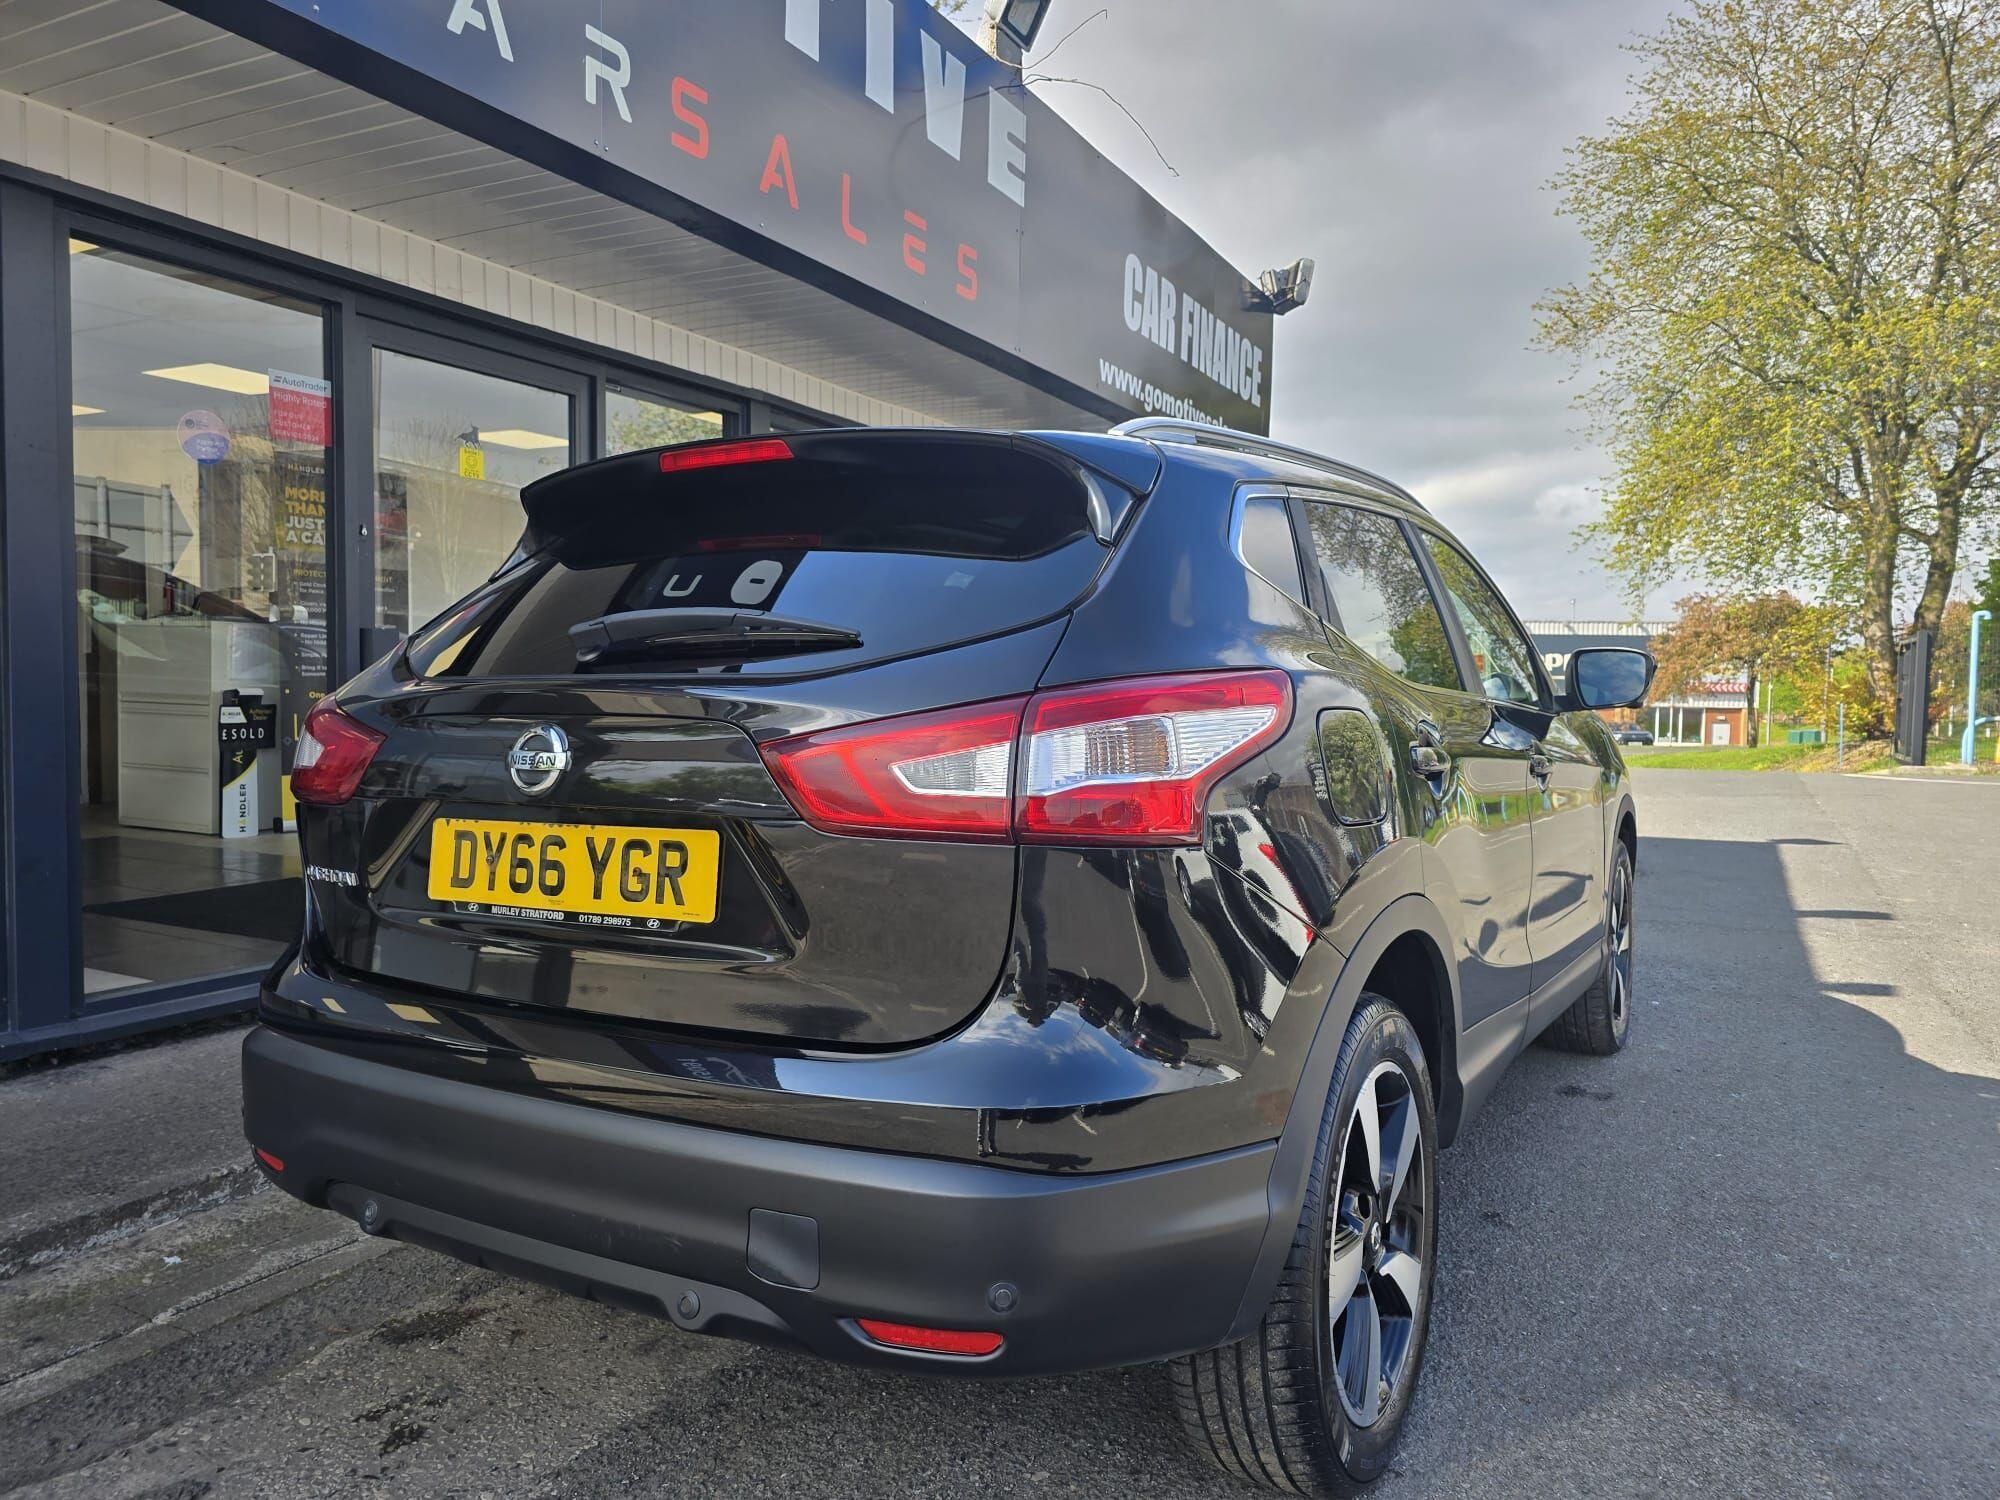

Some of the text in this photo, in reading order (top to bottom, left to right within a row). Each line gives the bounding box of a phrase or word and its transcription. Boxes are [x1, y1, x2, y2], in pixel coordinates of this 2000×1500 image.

[671, 76, 978, 301] SALES
[1123, 253, 1262, 407] CAR FINANCE
[282, 376, 328, 393] AutoTrader
[1099, 358, 1229, 429] www.gomotives
[273, 391, 300, 405] Highly
[285, 515, 325, 530] JUST
[286, 530, 326, 545] A CA
[510, 754, 556, 766] NISSAN
[450, 829, 689, 906] DY66 YGR
[491, 905, 631, 926] MURLEY STRATFORD 01789 298975
